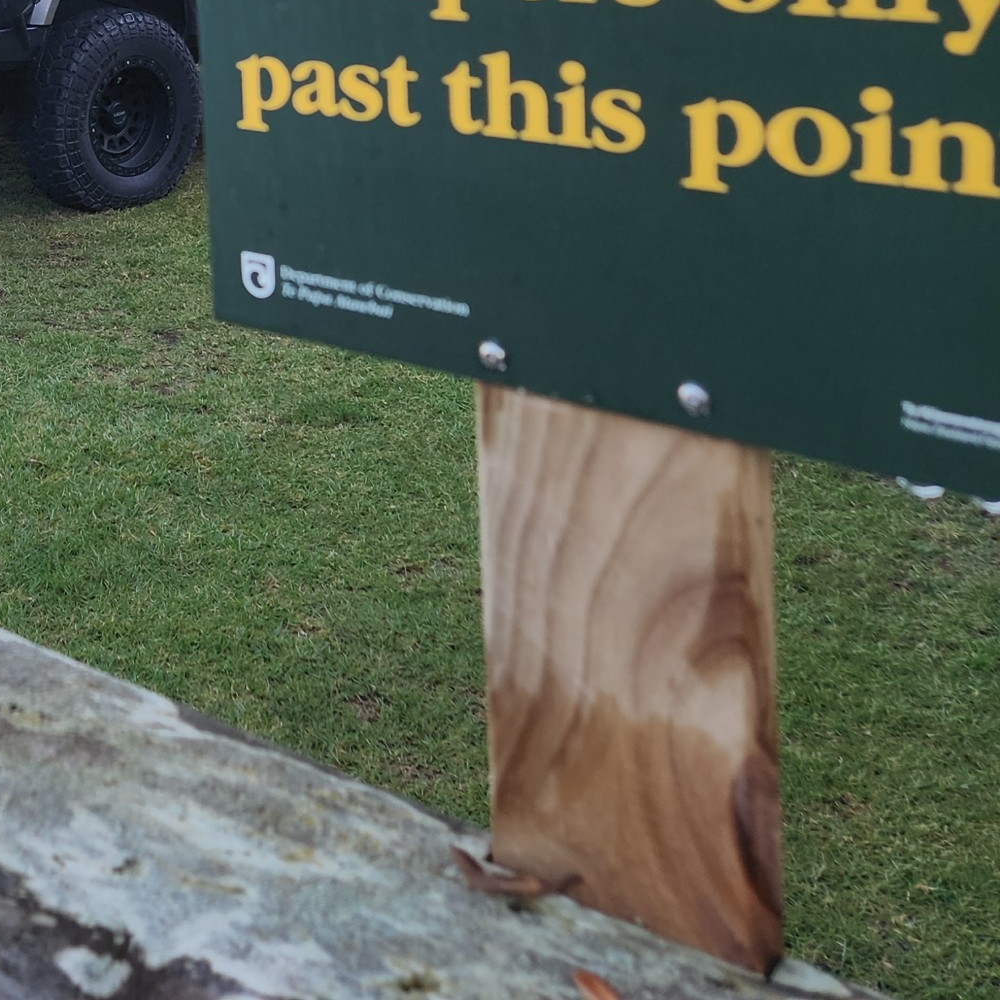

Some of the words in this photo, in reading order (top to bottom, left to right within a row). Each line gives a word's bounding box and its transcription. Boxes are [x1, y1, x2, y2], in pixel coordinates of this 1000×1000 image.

[236, 55, 420, 132] past
[443, 51, 646, 154] this
[681, 86, 1000, 199] poin
